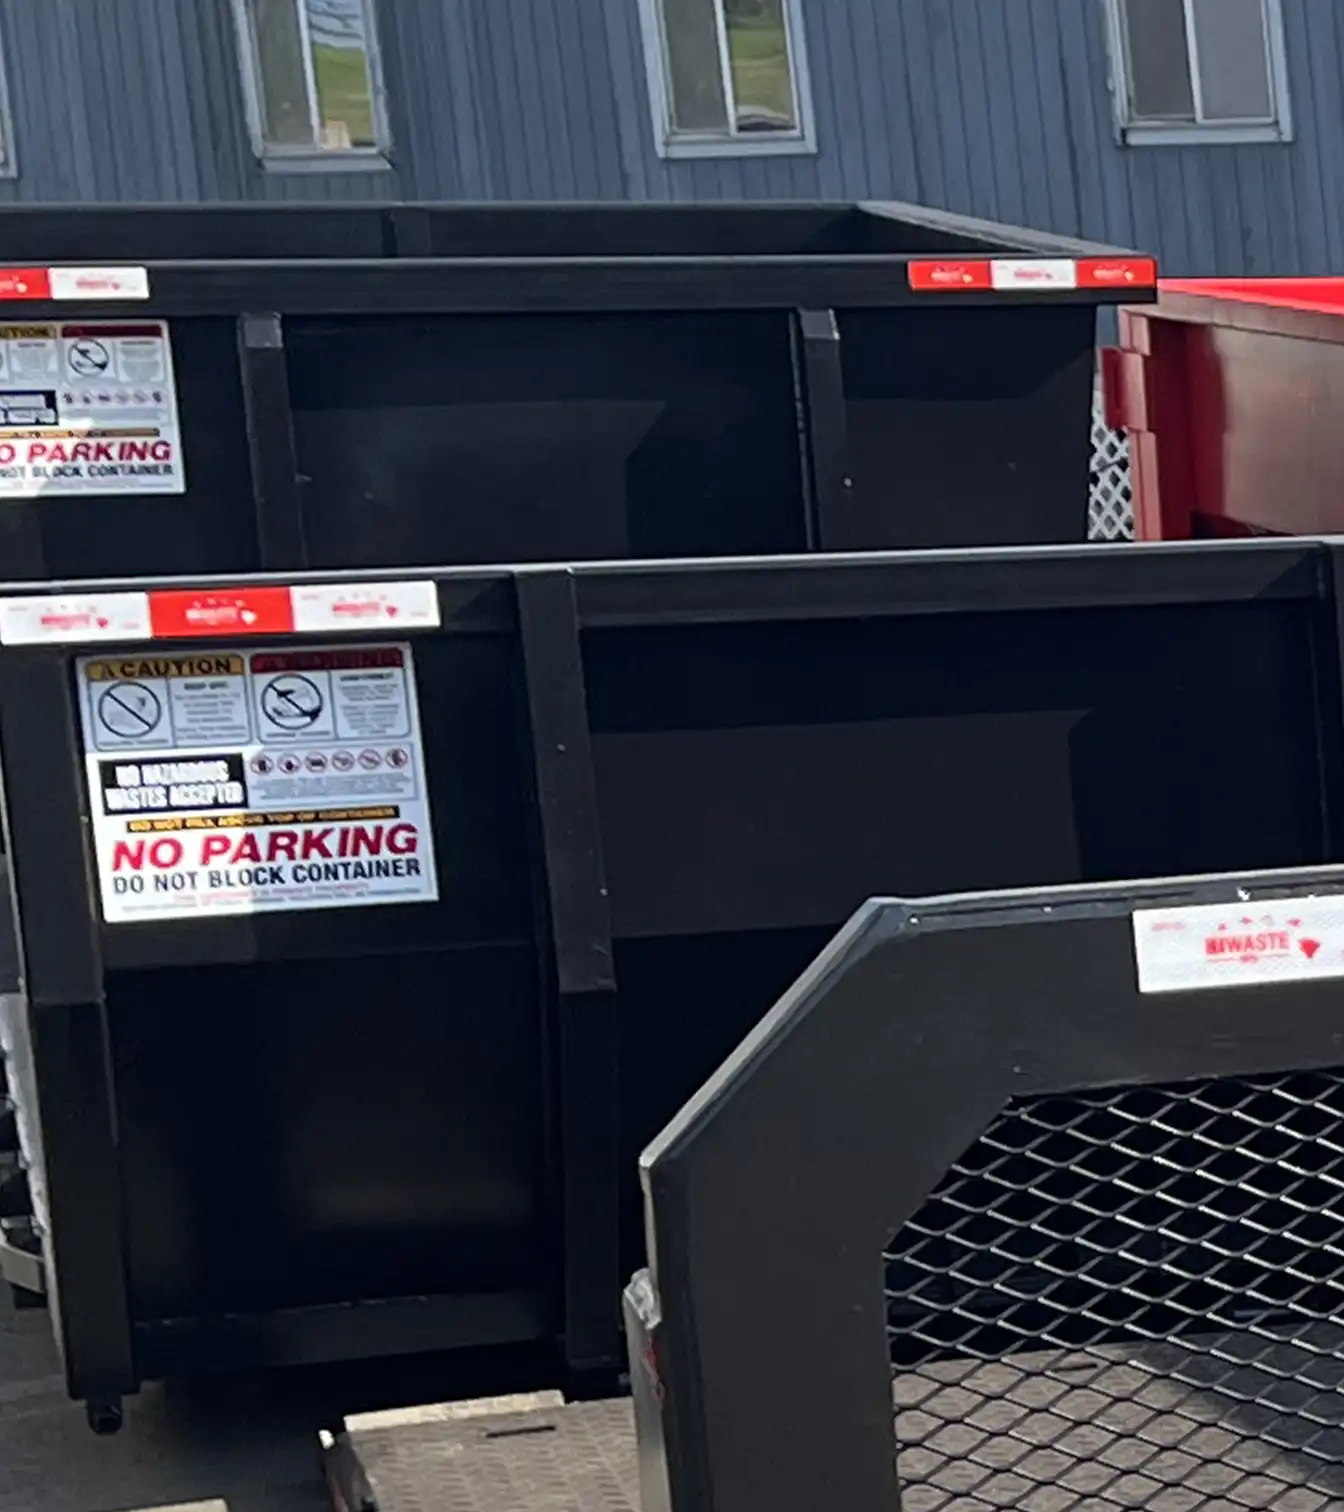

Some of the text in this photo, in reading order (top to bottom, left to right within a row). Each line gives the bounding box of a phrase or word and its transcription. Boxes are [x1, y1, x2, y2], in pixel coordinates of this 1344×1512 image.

[27, 440, 171, 463] PARKING
[120, 658, 230, 678] CAUTION
[112, 823, 418, 872] NO PARKING
[113, 857, 421, 894] DO NOT BLOCK CONTAINER
